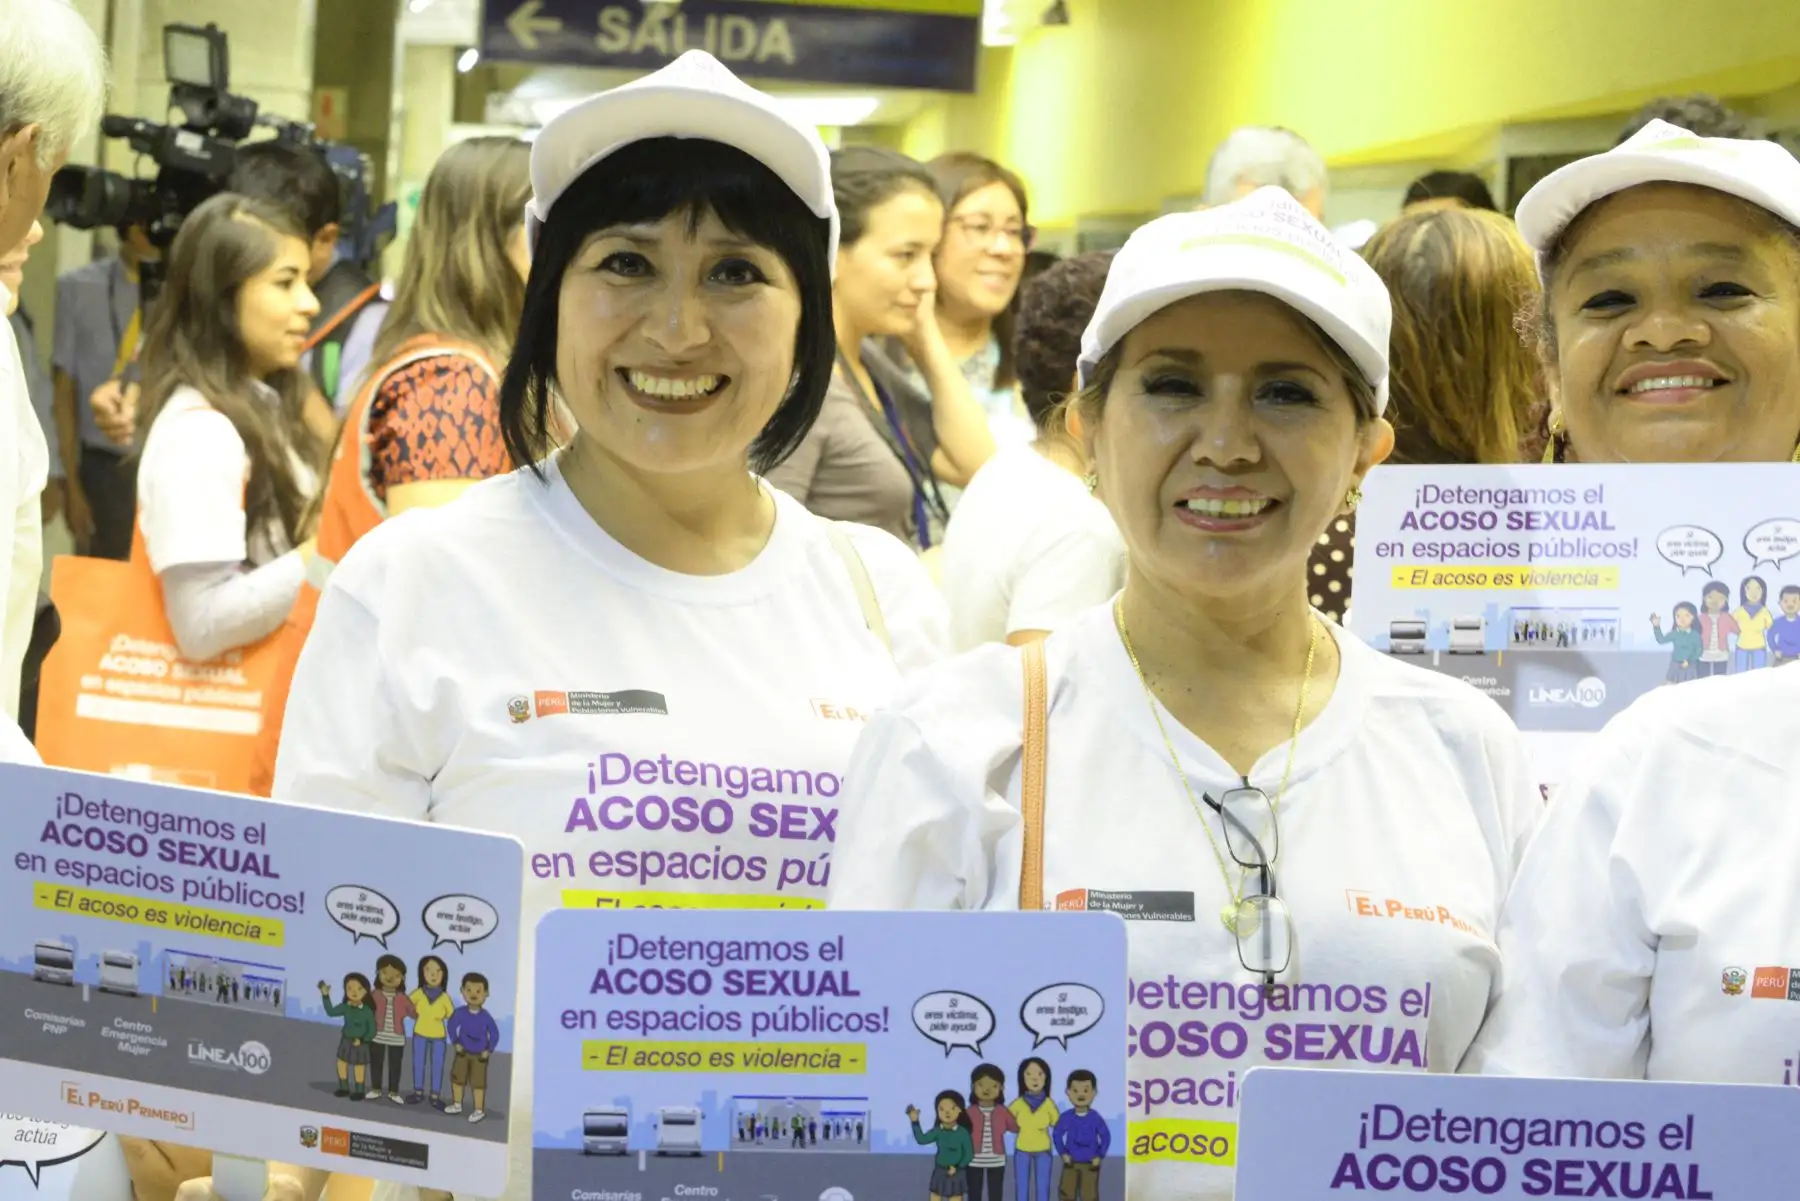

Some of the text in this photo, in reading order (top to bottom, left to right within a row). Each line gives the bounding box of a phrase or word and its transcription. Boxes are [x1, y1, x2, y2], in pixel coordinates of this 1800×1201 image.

[596, 4, 795, 65] SALIDA
[1414, 484, 1604, 510] ¡Detengamos el
[1400, 510, 1616, 532] ACOSO SEXUAL
[1375, 536, 1639, 562] en espacios públicos!
[1410, 570, 1428, 586] El
[1432, 573, 1489, 587] acoso
[1493, 573, 1514, 587] es
[1519, 570, 1599, 587] violencia
[587, 752, 844, 799] ¡Detengamo
[56, 792, 266, 845] ¡Detengamos el
[564, 796, 734, 834] ACOSO
[40, 820, 280, 879] ACOSO SEXUAL
[531, 850, 575, 878] en
[588, 846, 767, 886] espacios
[14, 851, 306, 914] en espacios públicos!
[1090, 891, 1133, 900] Ministerio
[54, 889, 74, 909] El
[78, 895, 138, 919] acoso
[144, 907, 168, 924] es
[174, 911, 262, 939] violencia
[1112, 902, 1137, 911] Mujer
[1142, 912, 1192, 921] Vulnerables
[607, 934, 844, 968] ¡Detengamos el
[590, 969, 860, 997] ACOSO SEXUAL
[1757, 975, 1785, 988] PERÚ
[1128, 975, 1431, 1020] etengamos el
[42, 1022, 68, 1035] PNP
[113, 1017, 152, 1033] Centro
[560, 1004, 889, 1036] en espacios públicos!
[101, 1027, 168, 1048] Emergencia
[117, 1041, 151, 1057] Mujer
[1128, 1021, 1428, 1068] OSO SEXUA
[606, 1046, 631, 1067] El
[634, 1051, 702, 1068] acoso
[708, 1052, 735, 1068] es
[742, 1047, 842, 1069] violencia
[14, 1127, 58, 1145] actúa
[1358, 1104, 1694, 1156] ¡Detengamos el
[1132, 1132, 1229, 1158] acoso
[1330, 1153, 1714, 1200] ACOSO SEXUAL
[674, 1184, 718, 1197] Centro
